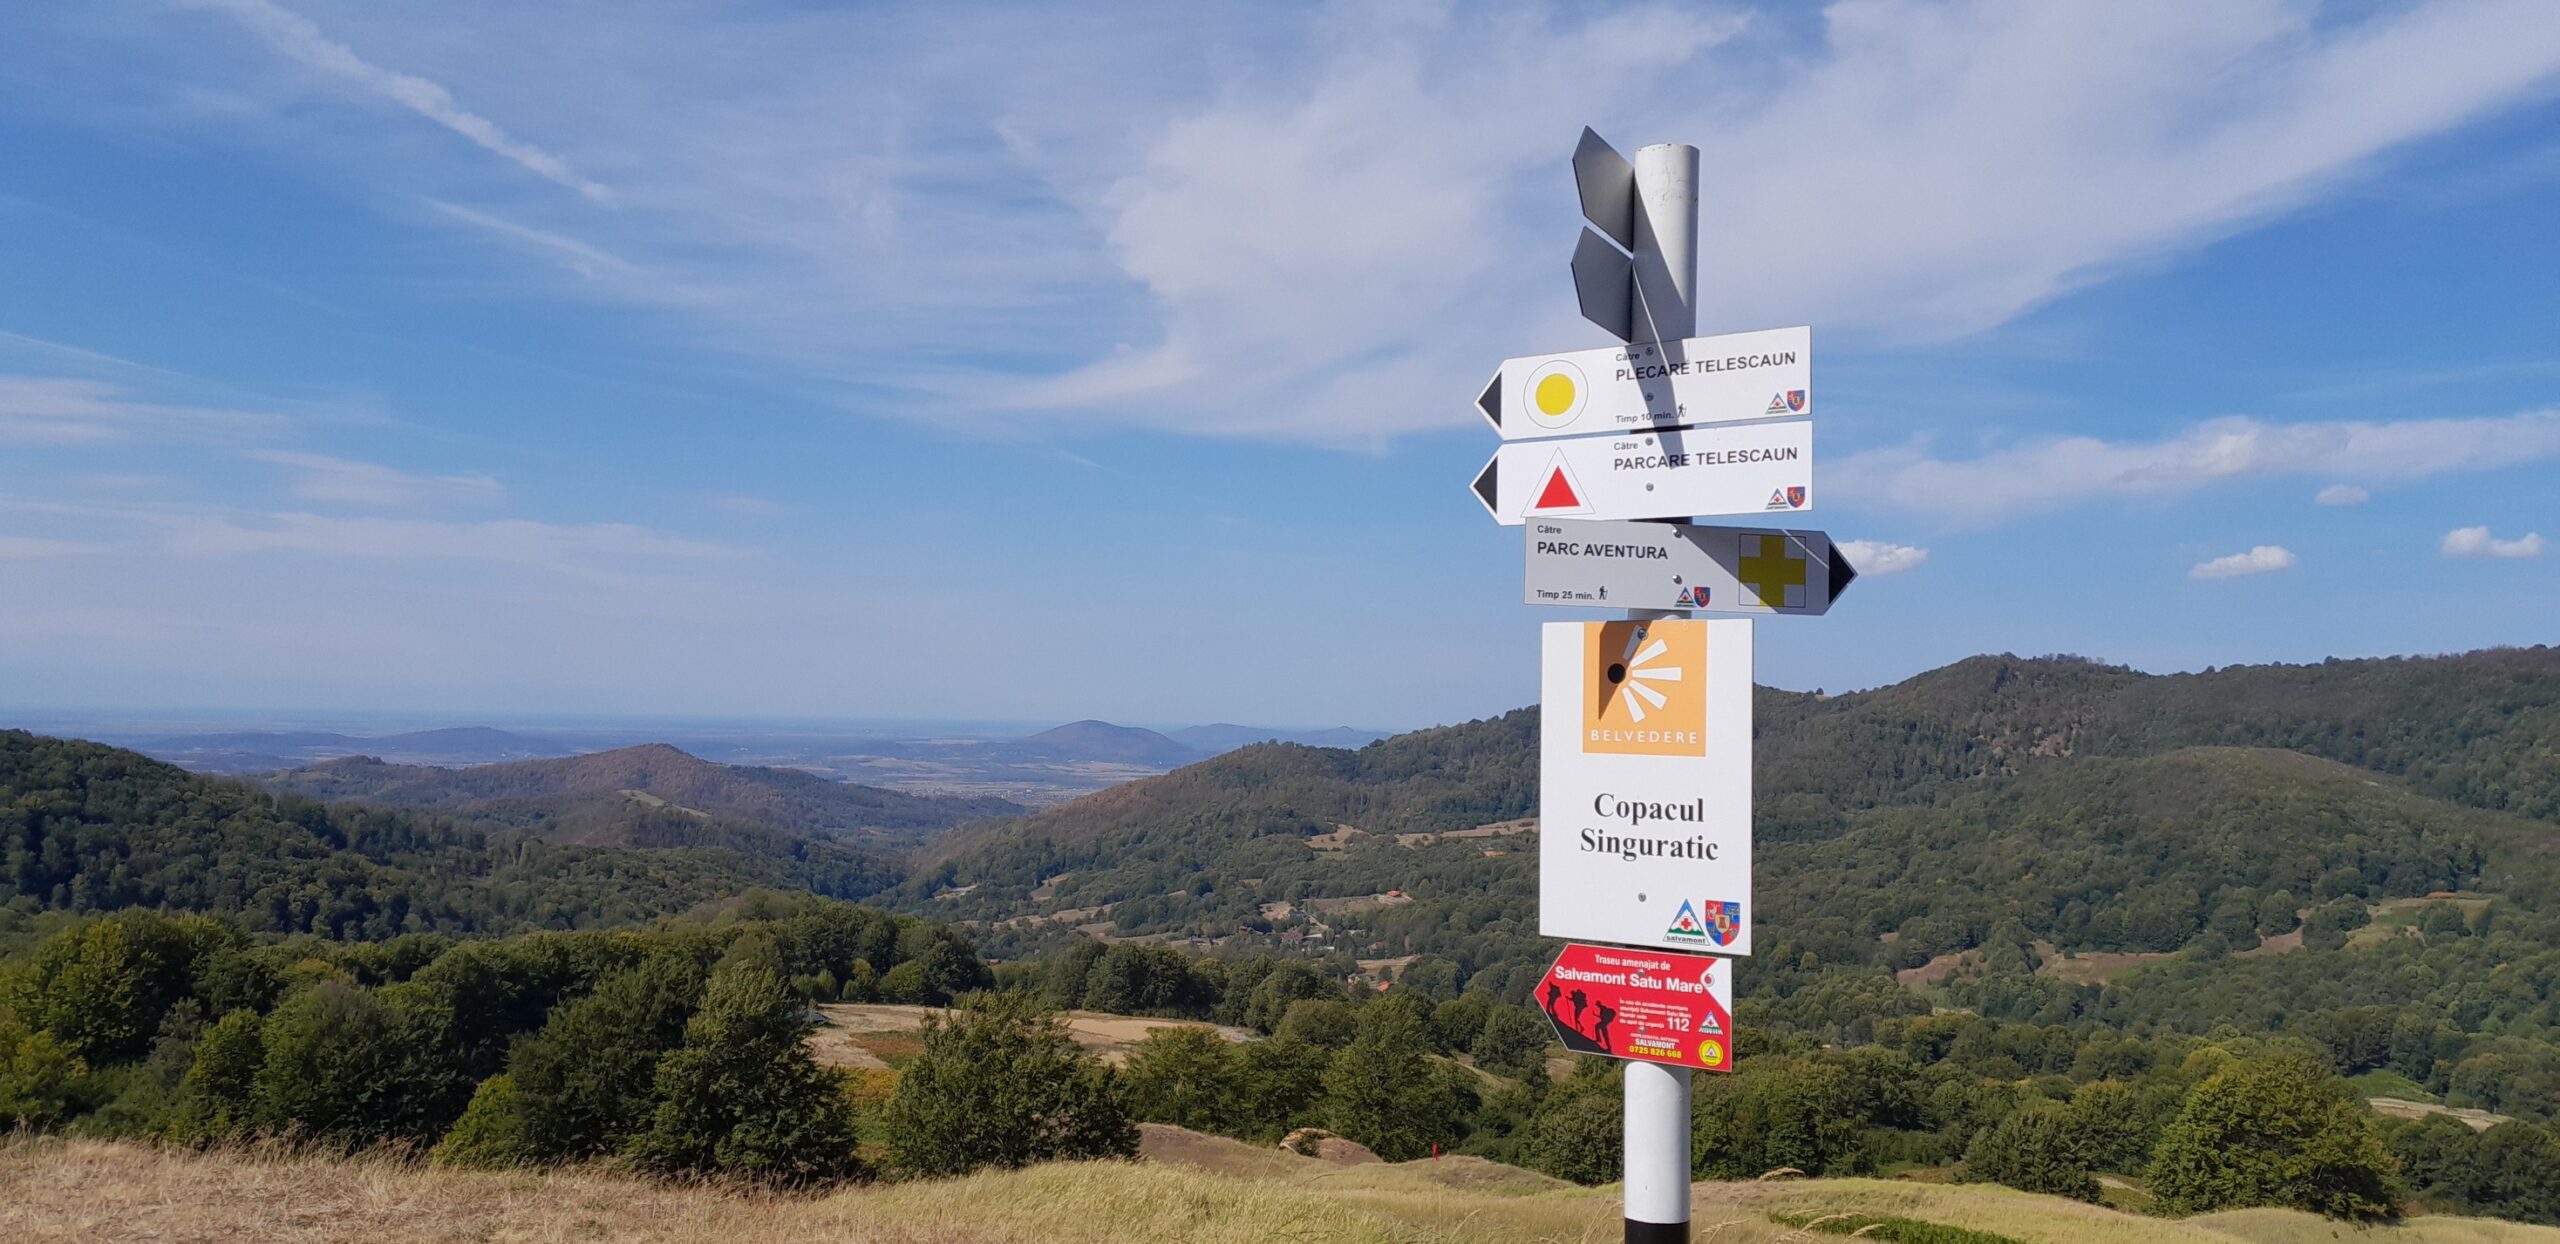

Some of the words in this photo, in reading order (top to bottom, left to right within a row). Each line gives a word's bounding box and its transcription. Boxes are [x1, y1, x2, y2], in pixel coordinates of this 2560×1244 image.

[1615, 362, 1690, 381] PLECARE
[1695, 351, 1796, 374] TELESCAUN
[1615, 414, 1638, 425] Timp
[1641, 412, 1652, 422] 10
[1654, 410, 1674, 420] min.
[1614, 453, 1690, 471] PARCARE
[1696, 447, 1798, 466] TELESCAUN
[1537, 541, 1580, 556] PARC
[1584, 543, 1668, 560] AVENTURA
[1536, 589, 1559, 600] Timp
[1562, 590, 1573, 600] 25
[1575, 591, 1595, 600] min.
[1591, 729, 1697, 744] BELVEDERE
[1593, 792, 1704, 827] Copacul
[1580, 827, 1719, 862] Singuratic
[1666, 934, 1706, 945] salvamont
[1594, 954, 1621, 966] Traseu
[1621, 958, 1659, 971] amenajat
[1661, 960, 1671, 971] de
[1554, 965, 1626, 986] Salvamont
[1629, 974, 1662, 990] Satu
[1666, 977, 1703, 994] Mare
[1667, 1016, 1690, 1032] 112
[1629, 1045, 1649, 1054] 0725
[1635, 1038, 1676, 1049] SALVAMONT
